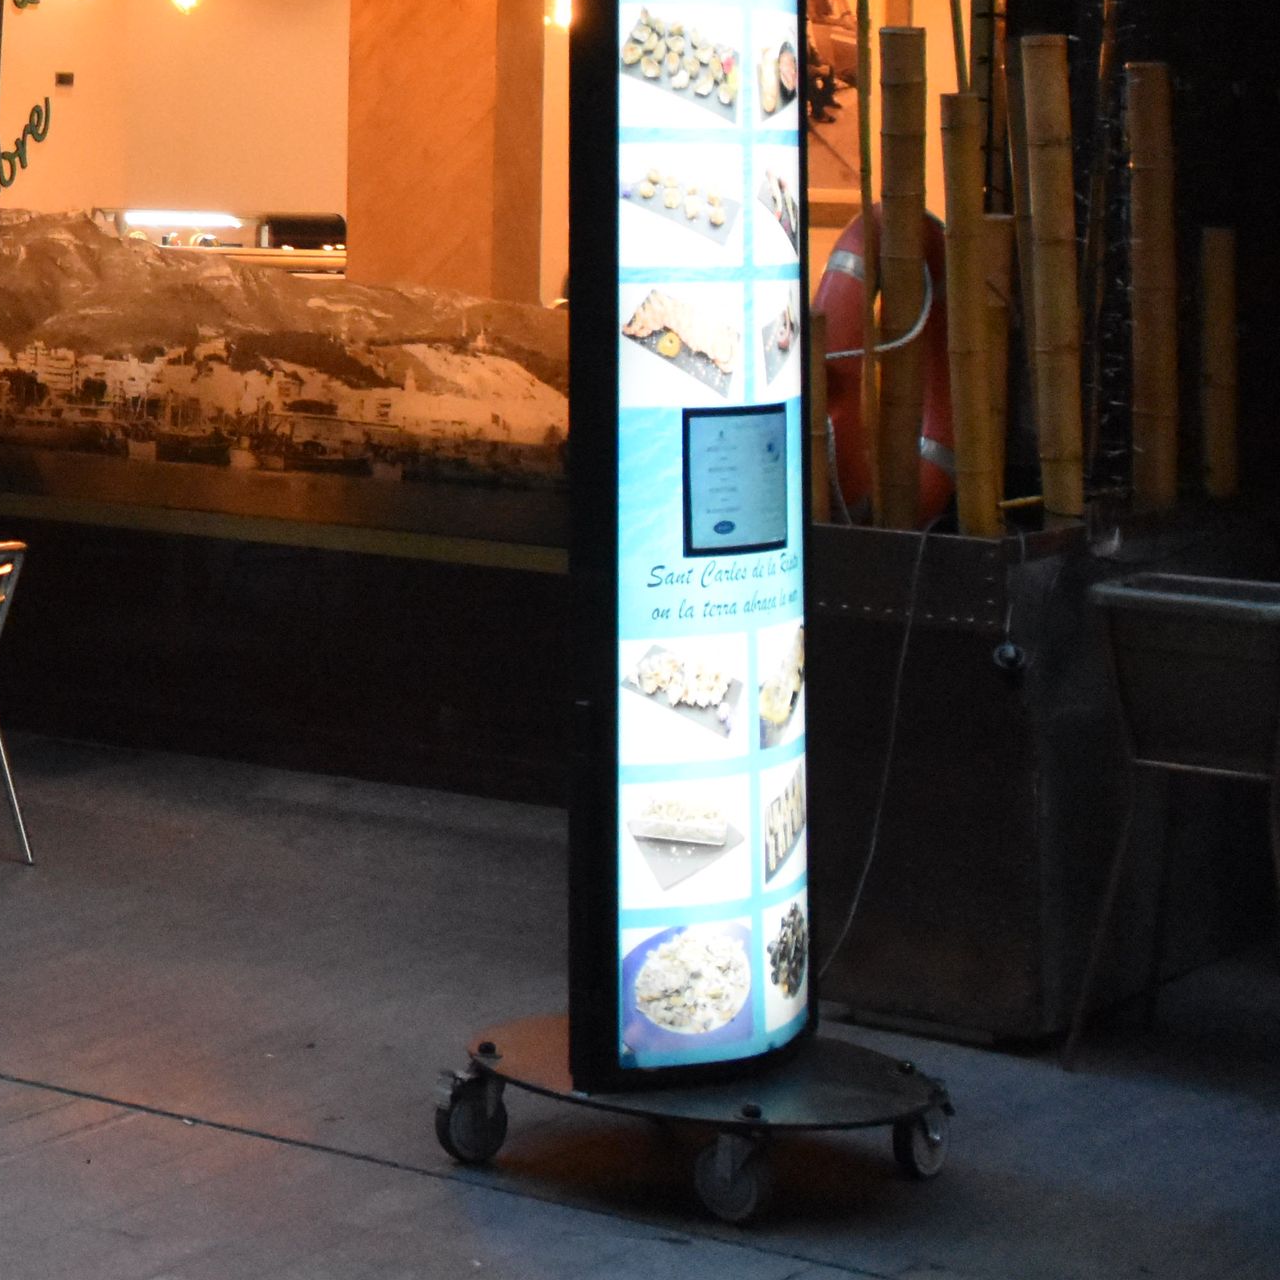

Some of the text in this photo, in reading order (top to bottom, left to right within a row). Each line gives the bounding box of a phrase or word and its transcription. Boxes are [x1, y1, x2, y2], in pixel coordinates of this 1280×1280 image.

[646, 564, 694, 588] Sant
[700, 559, 748, 589] Carles
[650, 605, 672, 621] on
[677, 597, 694, 620] la
[703, 599, 738, 619] terra
